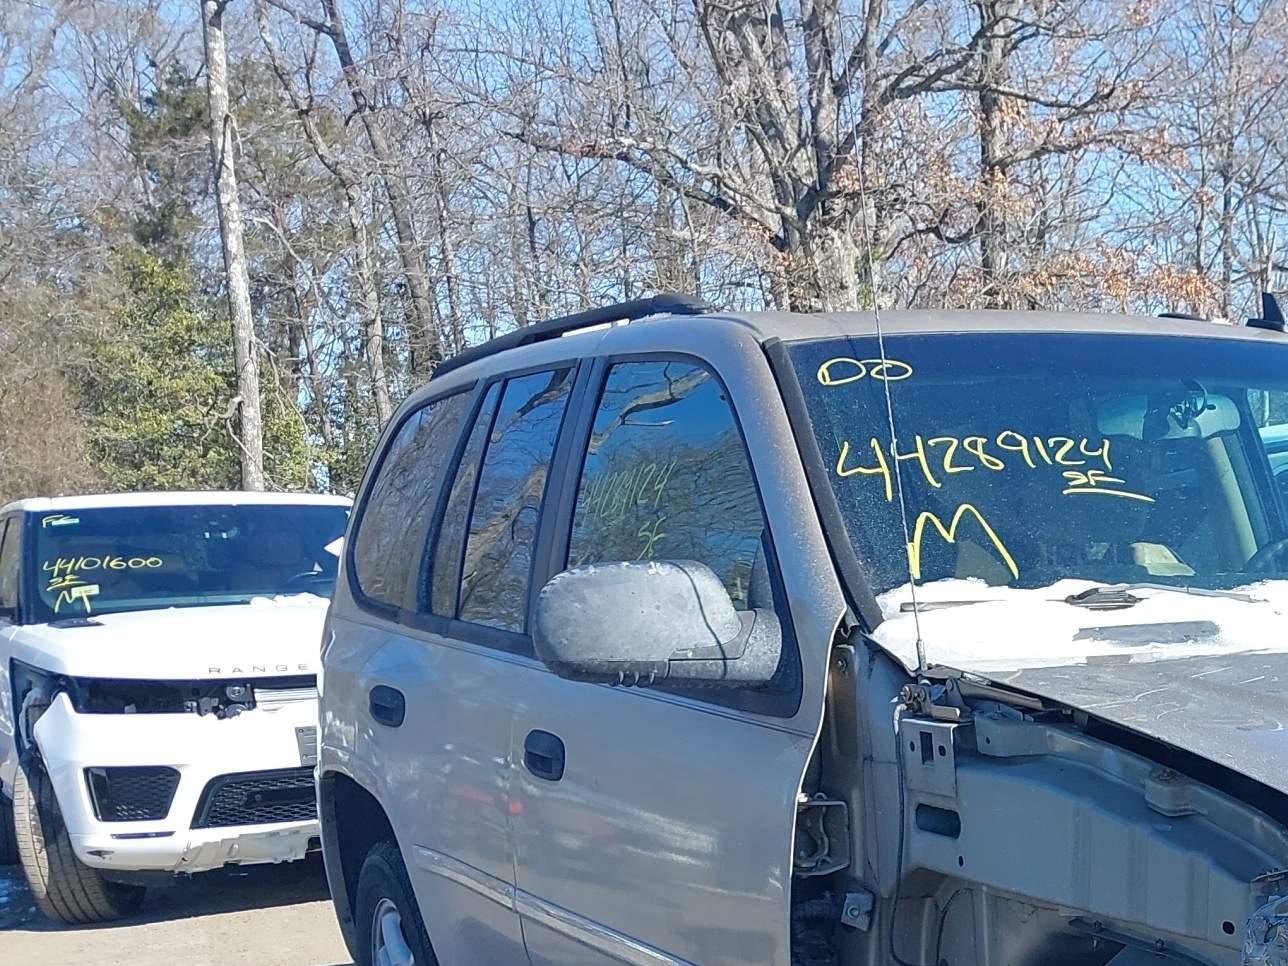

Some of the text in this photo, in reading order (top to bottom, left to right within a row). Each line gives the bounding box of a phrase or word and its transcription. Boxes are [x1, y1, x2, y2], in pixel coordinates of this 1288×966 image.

[836, 430, 1113, 502] 44289124
[907, 503, 1019, 580] M
[42, 555, 164, 577] 44101600
[208, 663, 309, 675] RANGE
